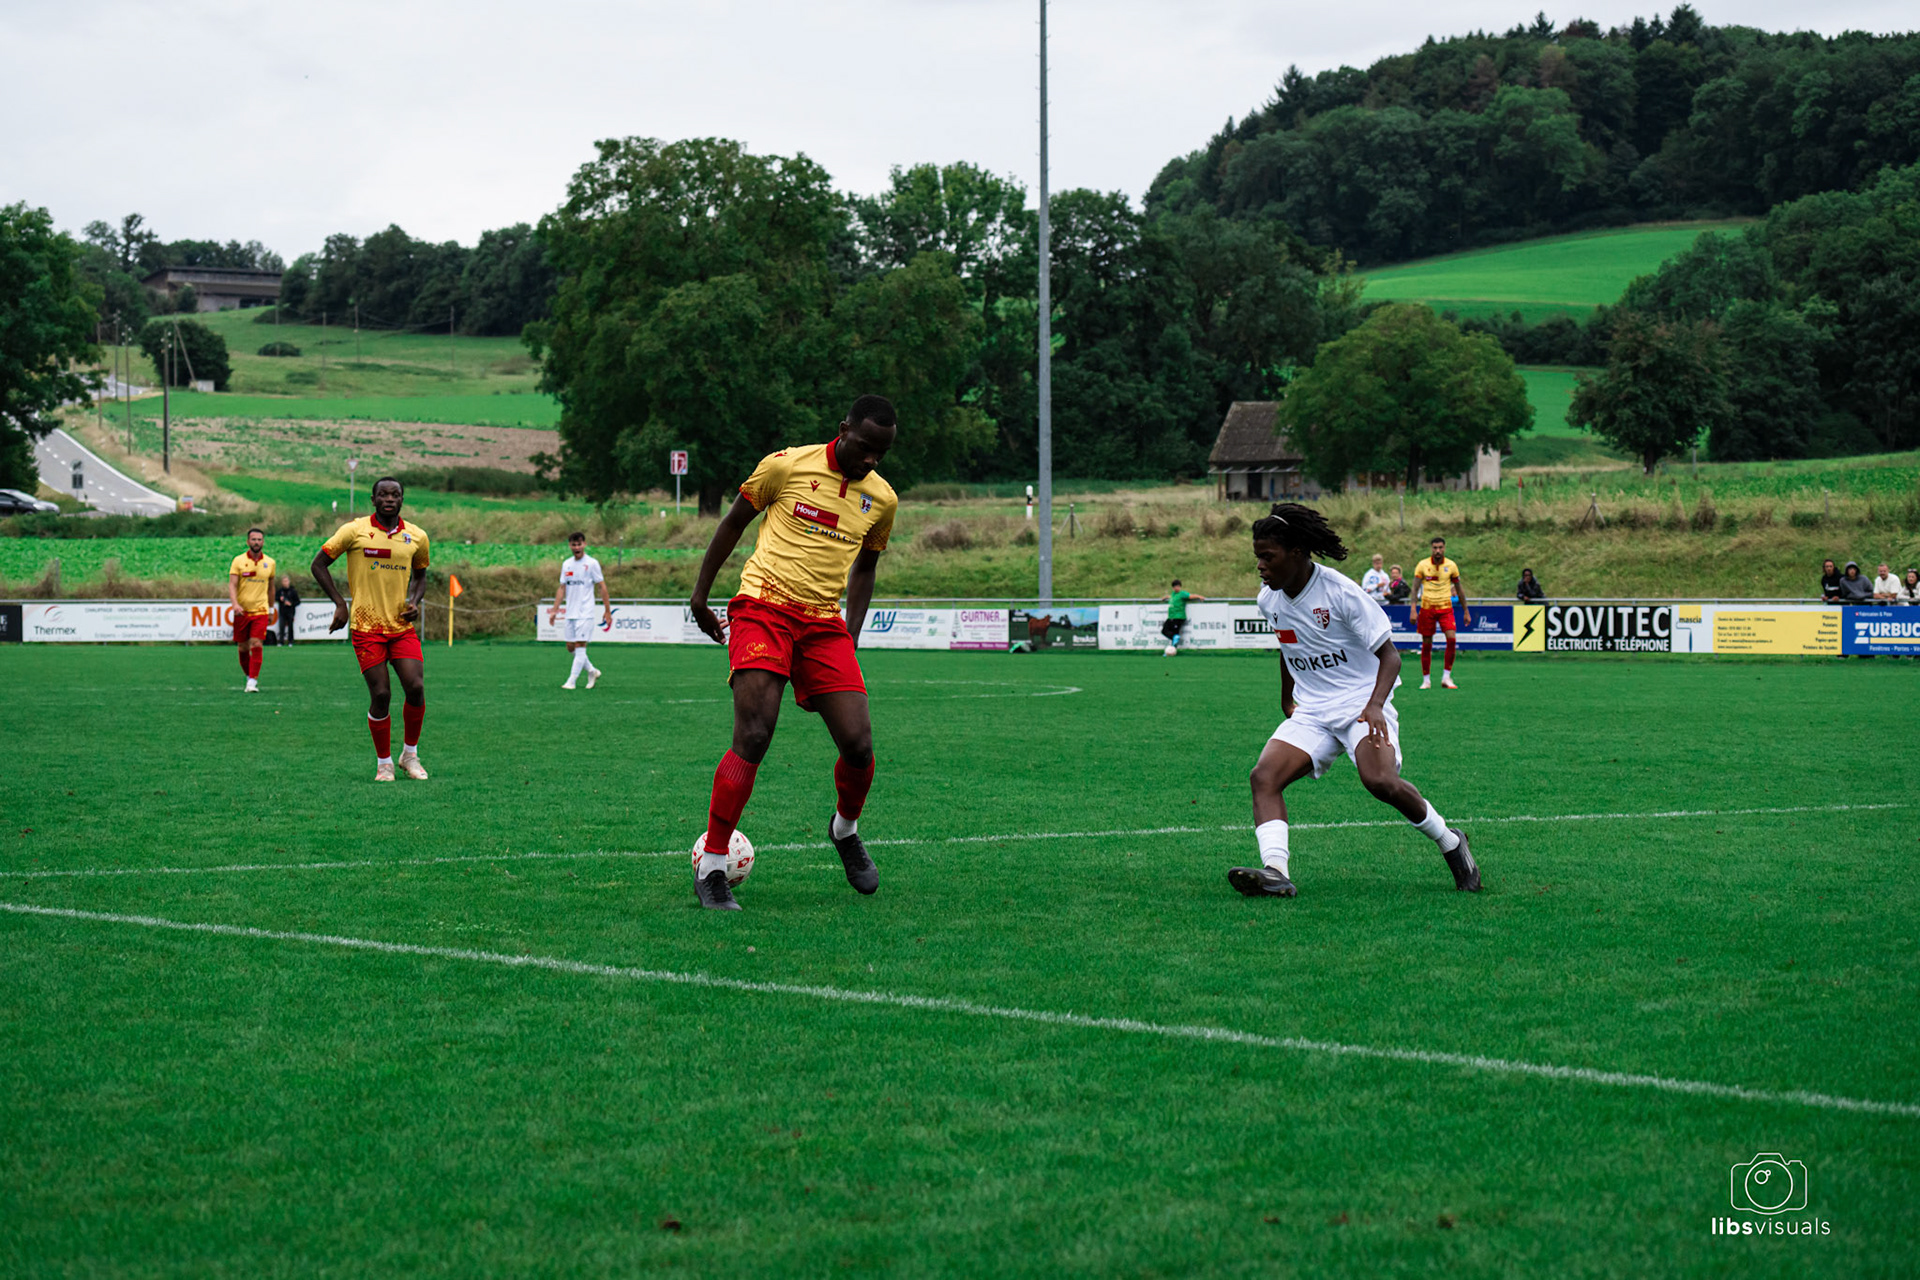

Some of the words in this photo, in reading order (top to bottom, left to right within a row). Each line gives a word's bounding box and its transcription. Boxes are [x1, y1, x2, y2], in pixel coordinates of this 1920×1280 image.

[796, 503, 819, 517] Hoval
[615, 616, 652, 630] ardentis
[961, 611, 1000, 622] GURTNER
[1547, 606, 1670, 638] SOVITEC
[1679, 616, 1702, 624] mascia
[34, 625, 77, 636] Thermex
[1547, 636, 1603, 651] ÉLECTRICITÉ
[1605, 640, 1613, 649] +
[1614, 636, 1670, 651] TÉLÉPHONE
